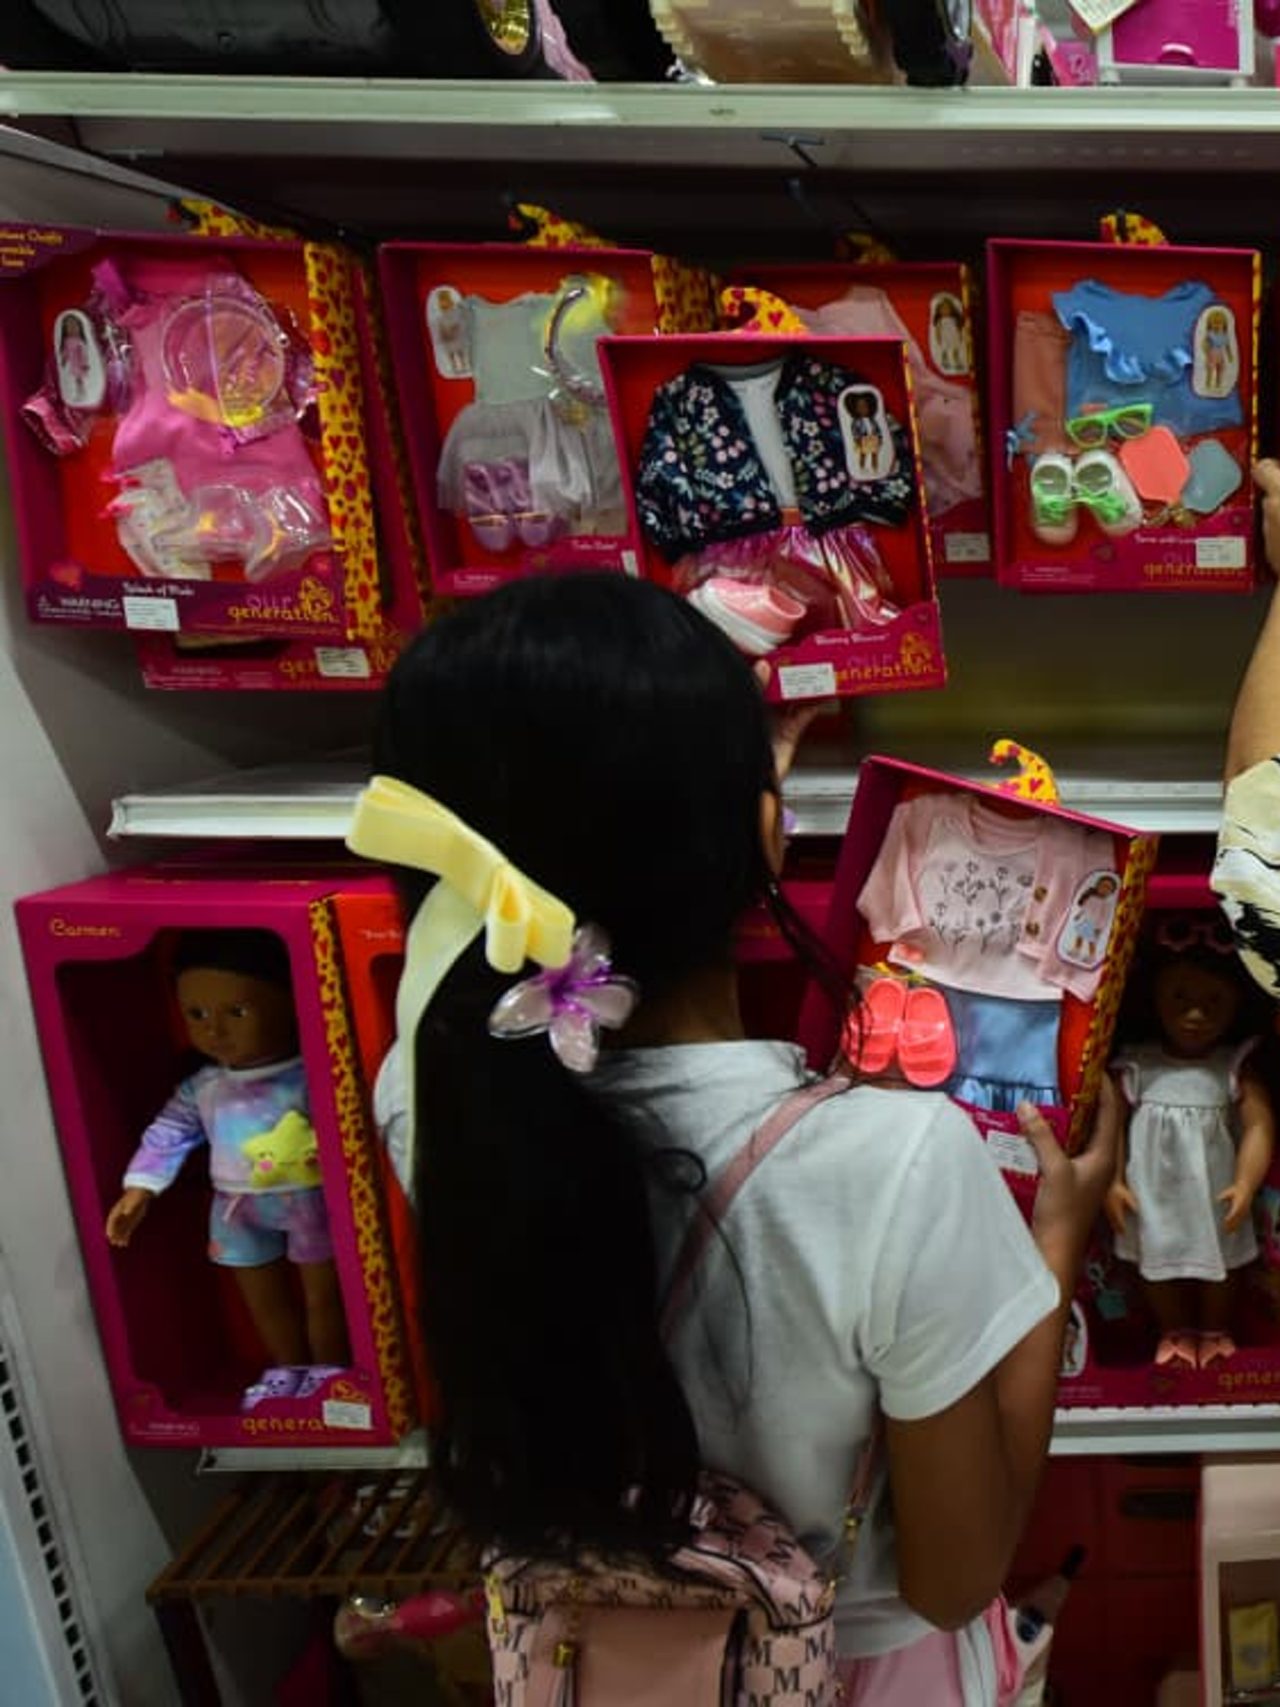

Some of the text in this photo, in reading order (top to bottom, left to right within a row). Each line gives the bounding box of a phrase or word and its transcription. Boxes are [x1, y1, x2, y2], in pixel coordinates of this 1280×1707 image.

[60, 598, 121, 611] WARNING
[227, 604, 341, 625] generation
[49, 918, 121, 937] Carmen
[243, 1414, 329, 1434] genera
